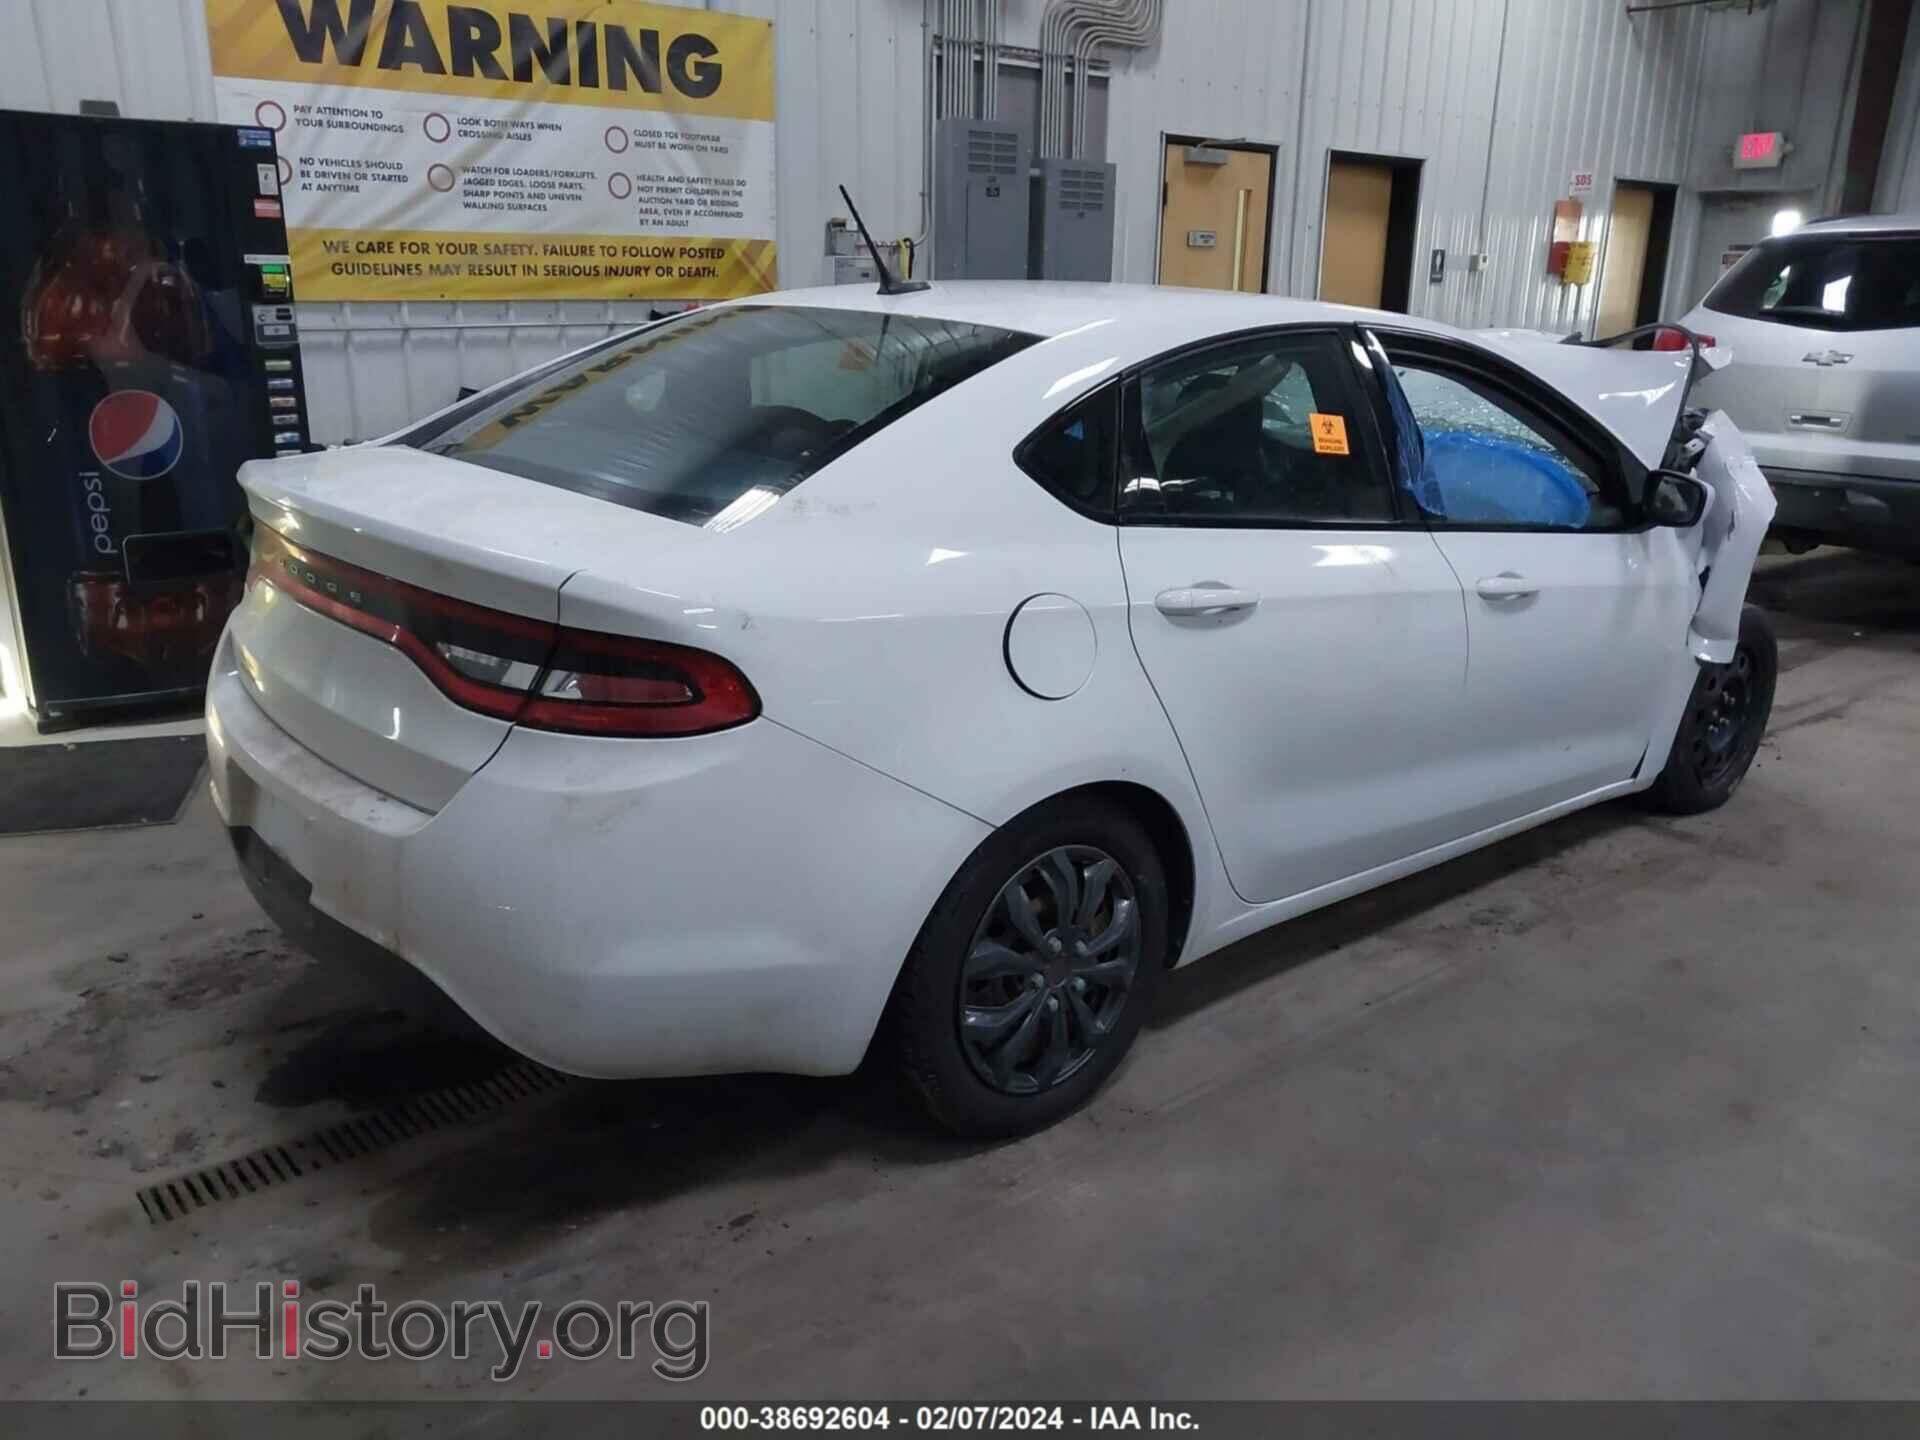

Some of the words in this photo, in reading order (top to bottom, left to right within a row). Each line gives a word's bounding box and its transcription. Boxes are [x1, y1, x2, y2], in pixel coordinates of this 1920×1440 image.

[276, 0, 722, 98] WARNING
[294, 105, 314, 115] PAY
[316, 106, 369, 117] ATTENTION
[372, 110, 383, 119] TO
[295, 118, 324, 128] YOUR
[326, 120, 404, 133] SURROUNDINGS
[300, 157, 314, 167] NO
[318, 158, 362, 169] VEHICLES
[364, 160, 403, 170] SHOULD
[300, 170, 312, 180] BE
[314, 170, 351, 181] DRIVEN
[354, 172, 368, 182] OR
[370, 172, 409, 183] STARTED
[301, 183, 314, 192] AT
[316, 184, 360, 193] ANYTIME
[322, 240, 350, 254] WE
[356, 240, 394, 254] CARE
[400, 241, 430, 255] FOR
[435, 242, 479, 256] YOUR
[543, 244, 596, 257] FAILURE
[600, 245, 618, 258] TO
[622, 246, 675, 259] FOLLOW
[680, 247, 725, 260] POSTED
[331, 262, 423, 276] GUIDELINES
[428, 263, 462, 276] MAY
[468, 263, 518, 277] RESULT
[522, 264, 538, 277] IN
[544, 264, 600, 277] SERIOUS
[604, 265, 650, 278] INJURY
[656, 266, 674, 278] OR
[79, 472, 118, 553] pepsi
